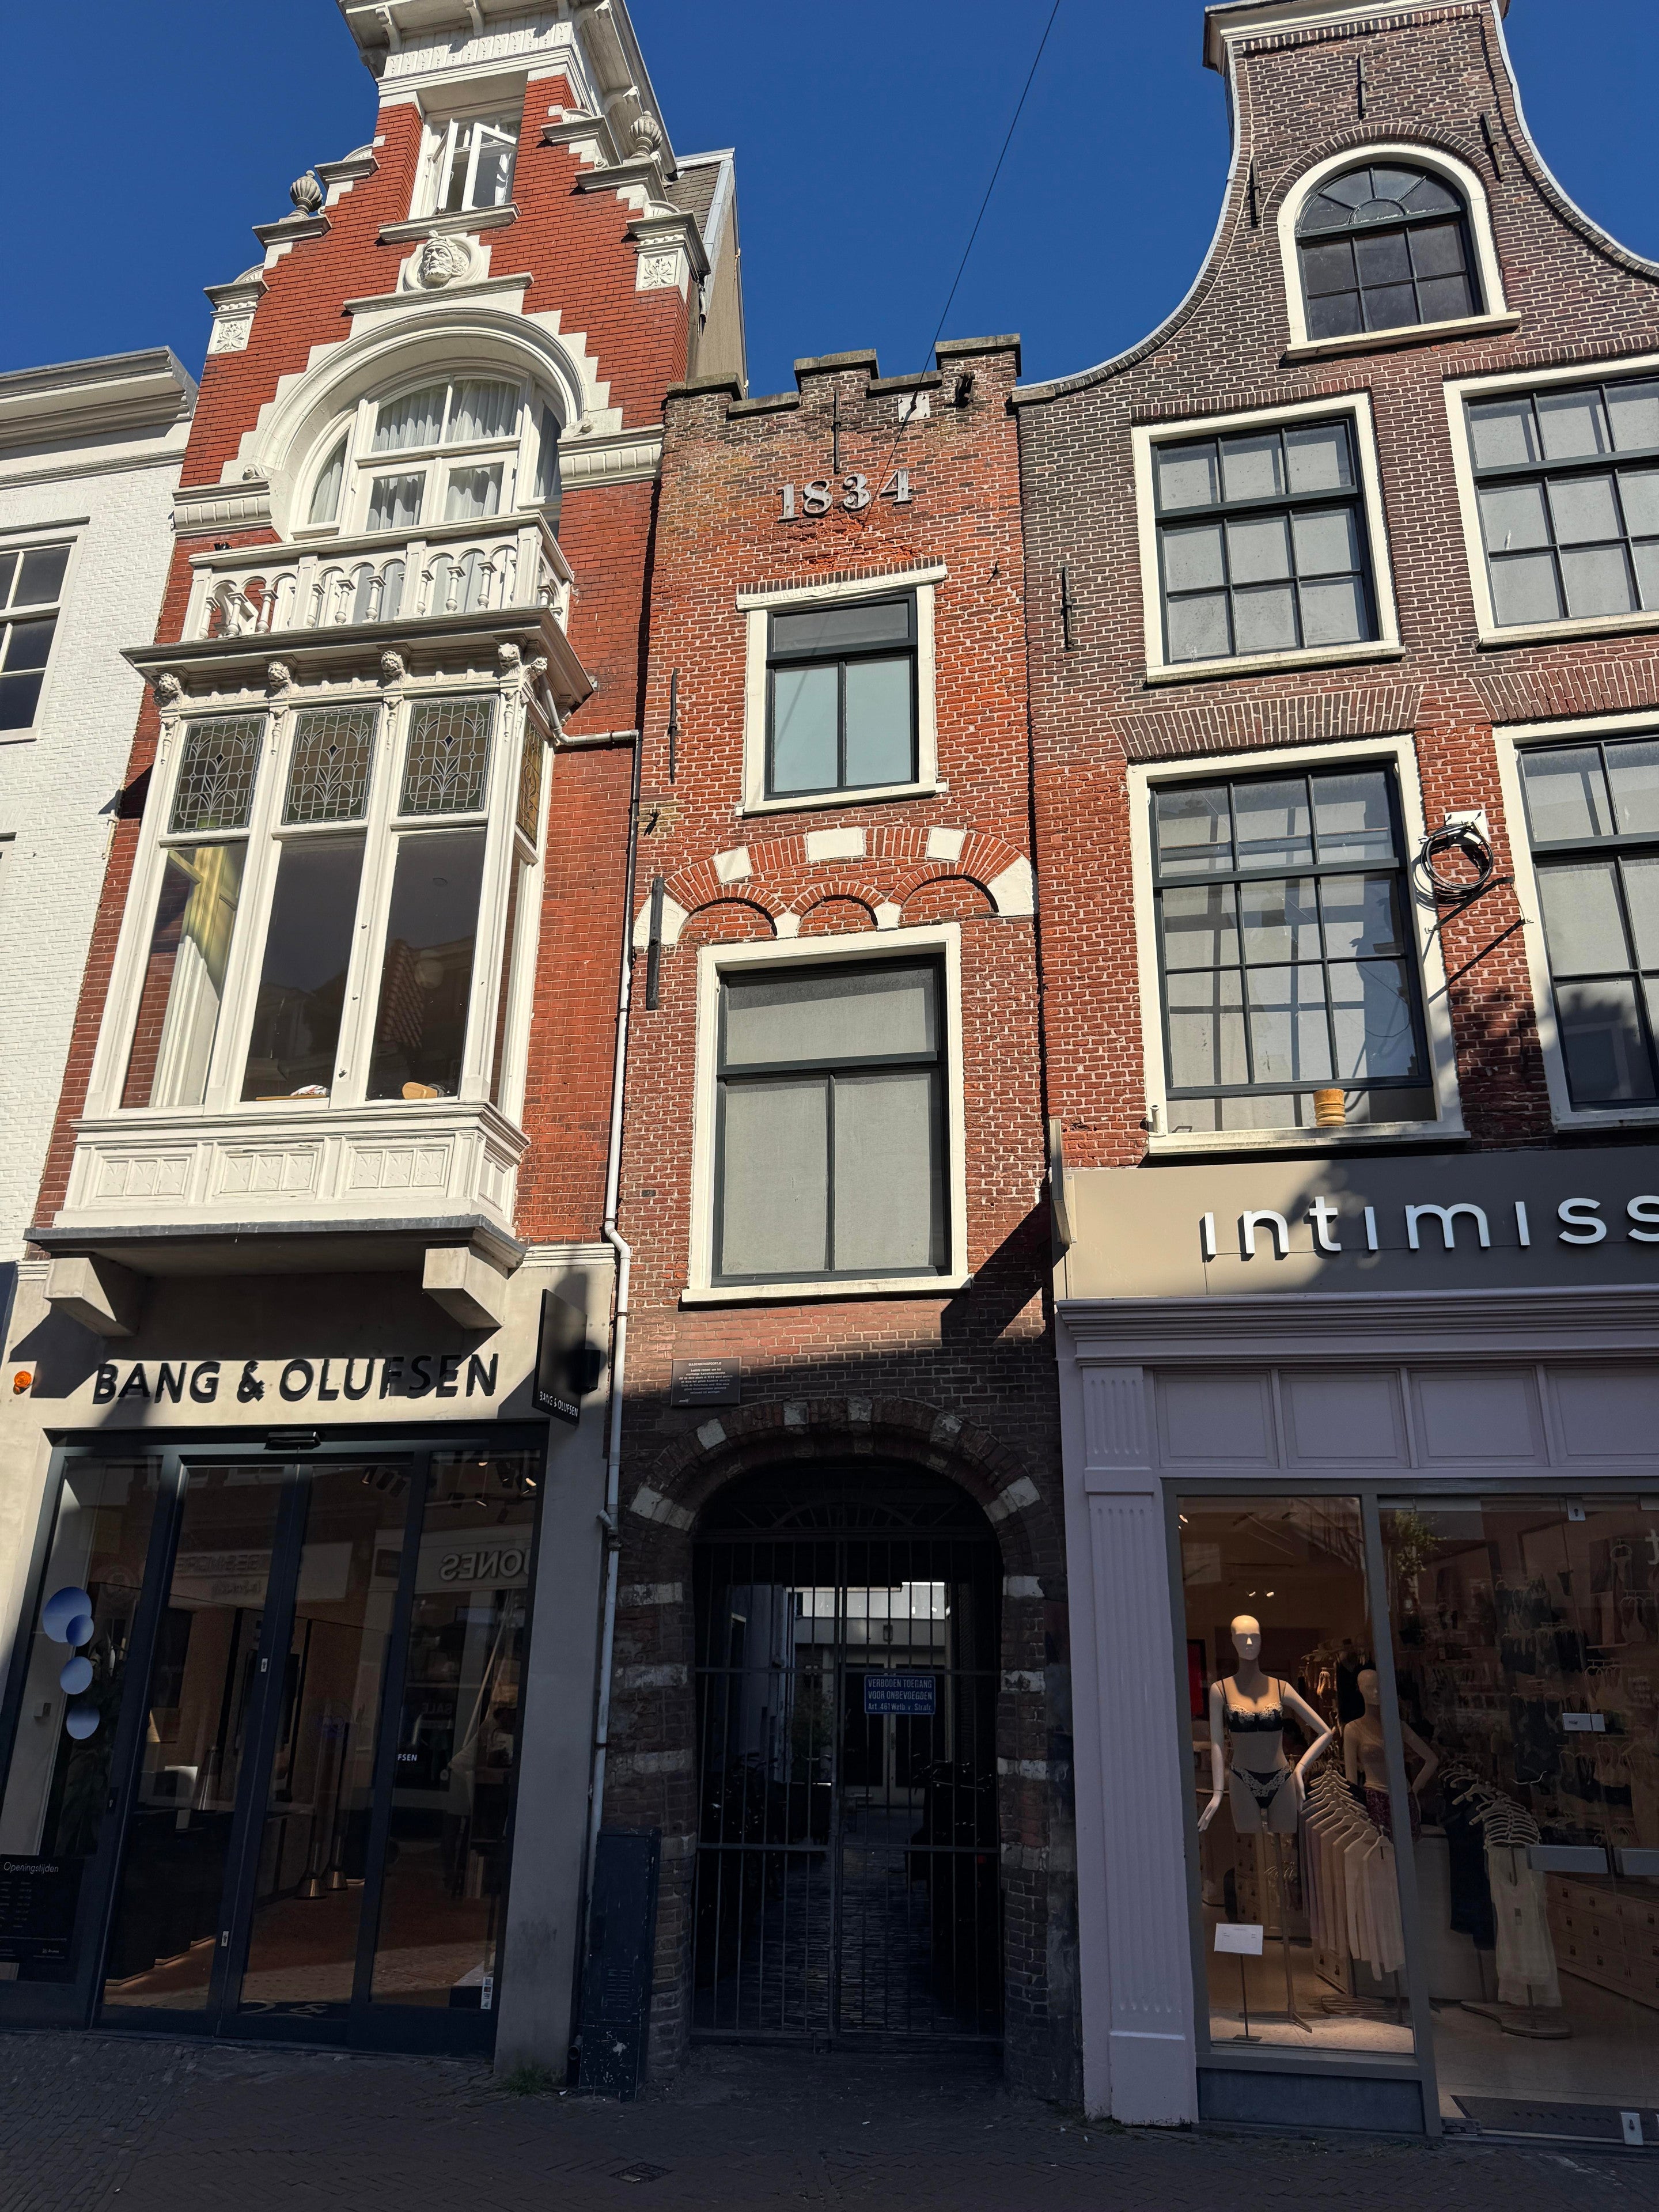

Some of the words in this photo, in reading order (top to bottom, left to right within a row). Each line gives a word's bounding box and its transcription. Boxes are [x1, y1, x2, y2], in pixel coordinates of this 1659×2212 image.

[777, 467, 912, 520] 1834
[92, 1360, 221, 1404] BANG
[237, 1359, 265, 1403] &
[279, 1353, 499, 1402] OLUFSEN
[539, 1391, 554, 1406] BANG
[558, 1400, 578, 1417] OLUFSEN
[868, 1679, 901, 1687] VERBODEN
[903, 1679, 932, 1688] TOEGANG
[868, 1691, 885, 1699] VOOR
[887, 1691, 932, 1700] ONBEVOEGDEN
[3, 1862, 59, 1874] Openingstijden
